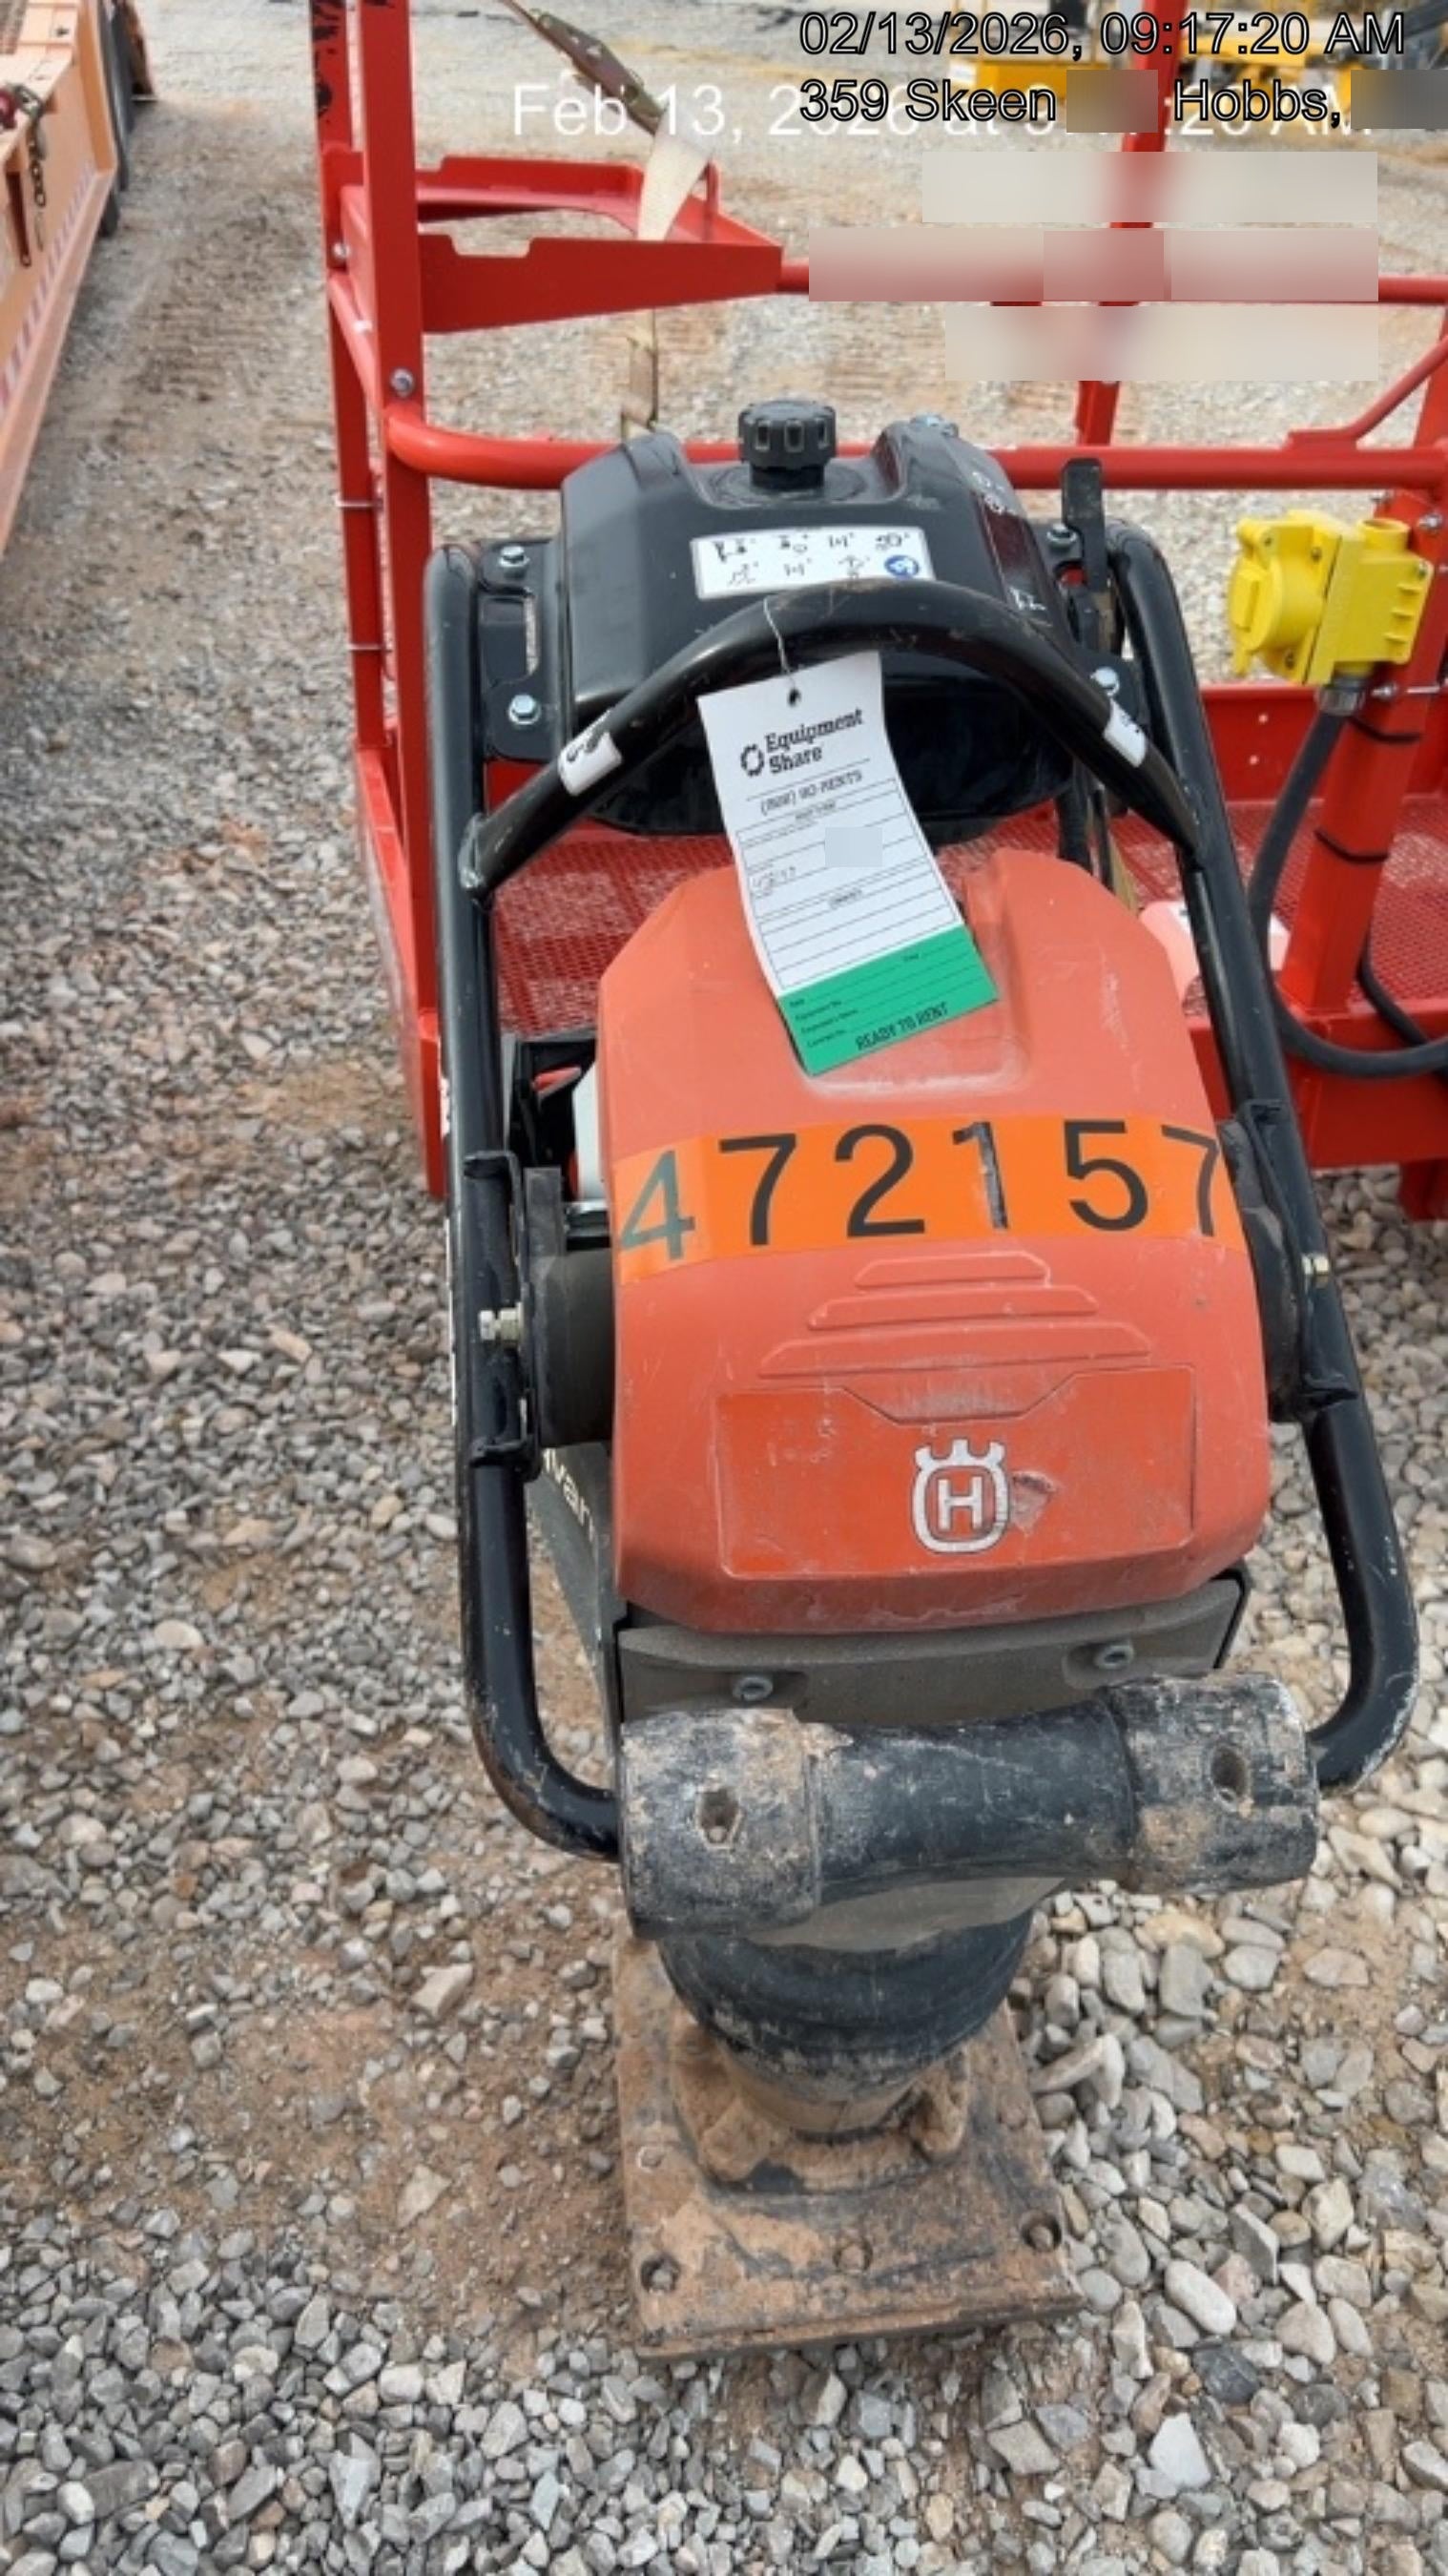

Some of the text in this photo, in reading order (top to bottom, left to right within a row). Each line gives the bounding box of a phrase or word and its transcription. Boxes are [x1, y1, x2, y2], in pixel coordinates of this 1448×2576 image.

[764, 707, 862, 754] Equipment
[769, 746, 822, 774] Share
[856, 1023, 897, 1050] READY
[898, 1016, 917, 1032] TO
[916, 1001, 948, 1026] RENT
[620, 1120, 1221, 1261] 472157
